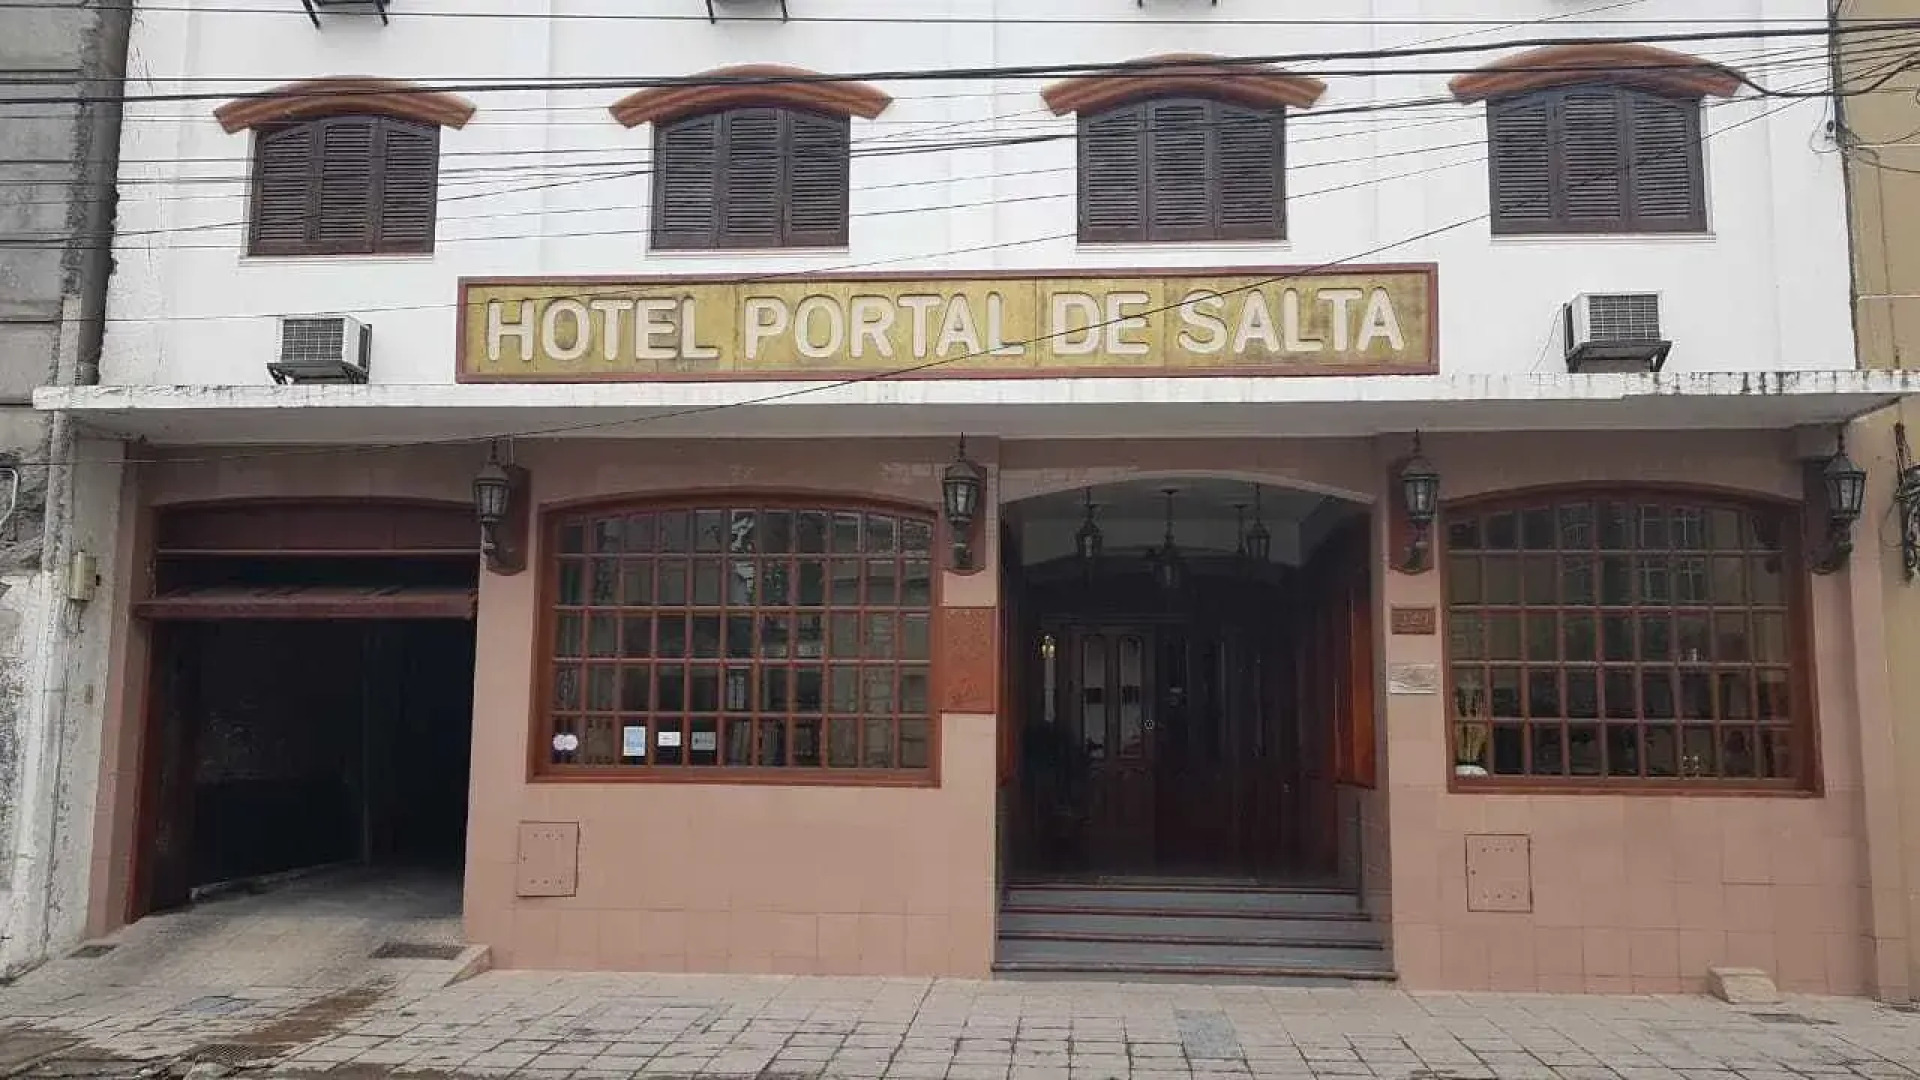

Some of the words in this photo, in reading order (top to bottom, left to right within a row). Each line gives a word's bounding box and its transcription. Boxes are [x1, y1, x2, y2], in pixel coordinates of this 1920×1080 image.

[486, 296, 719, 361] HOTEL
[744, 291, 1025, 360] PORTAL
[1051, 290, 1150, 355] DE
[1177, 287, 1405, 354] SALTA
